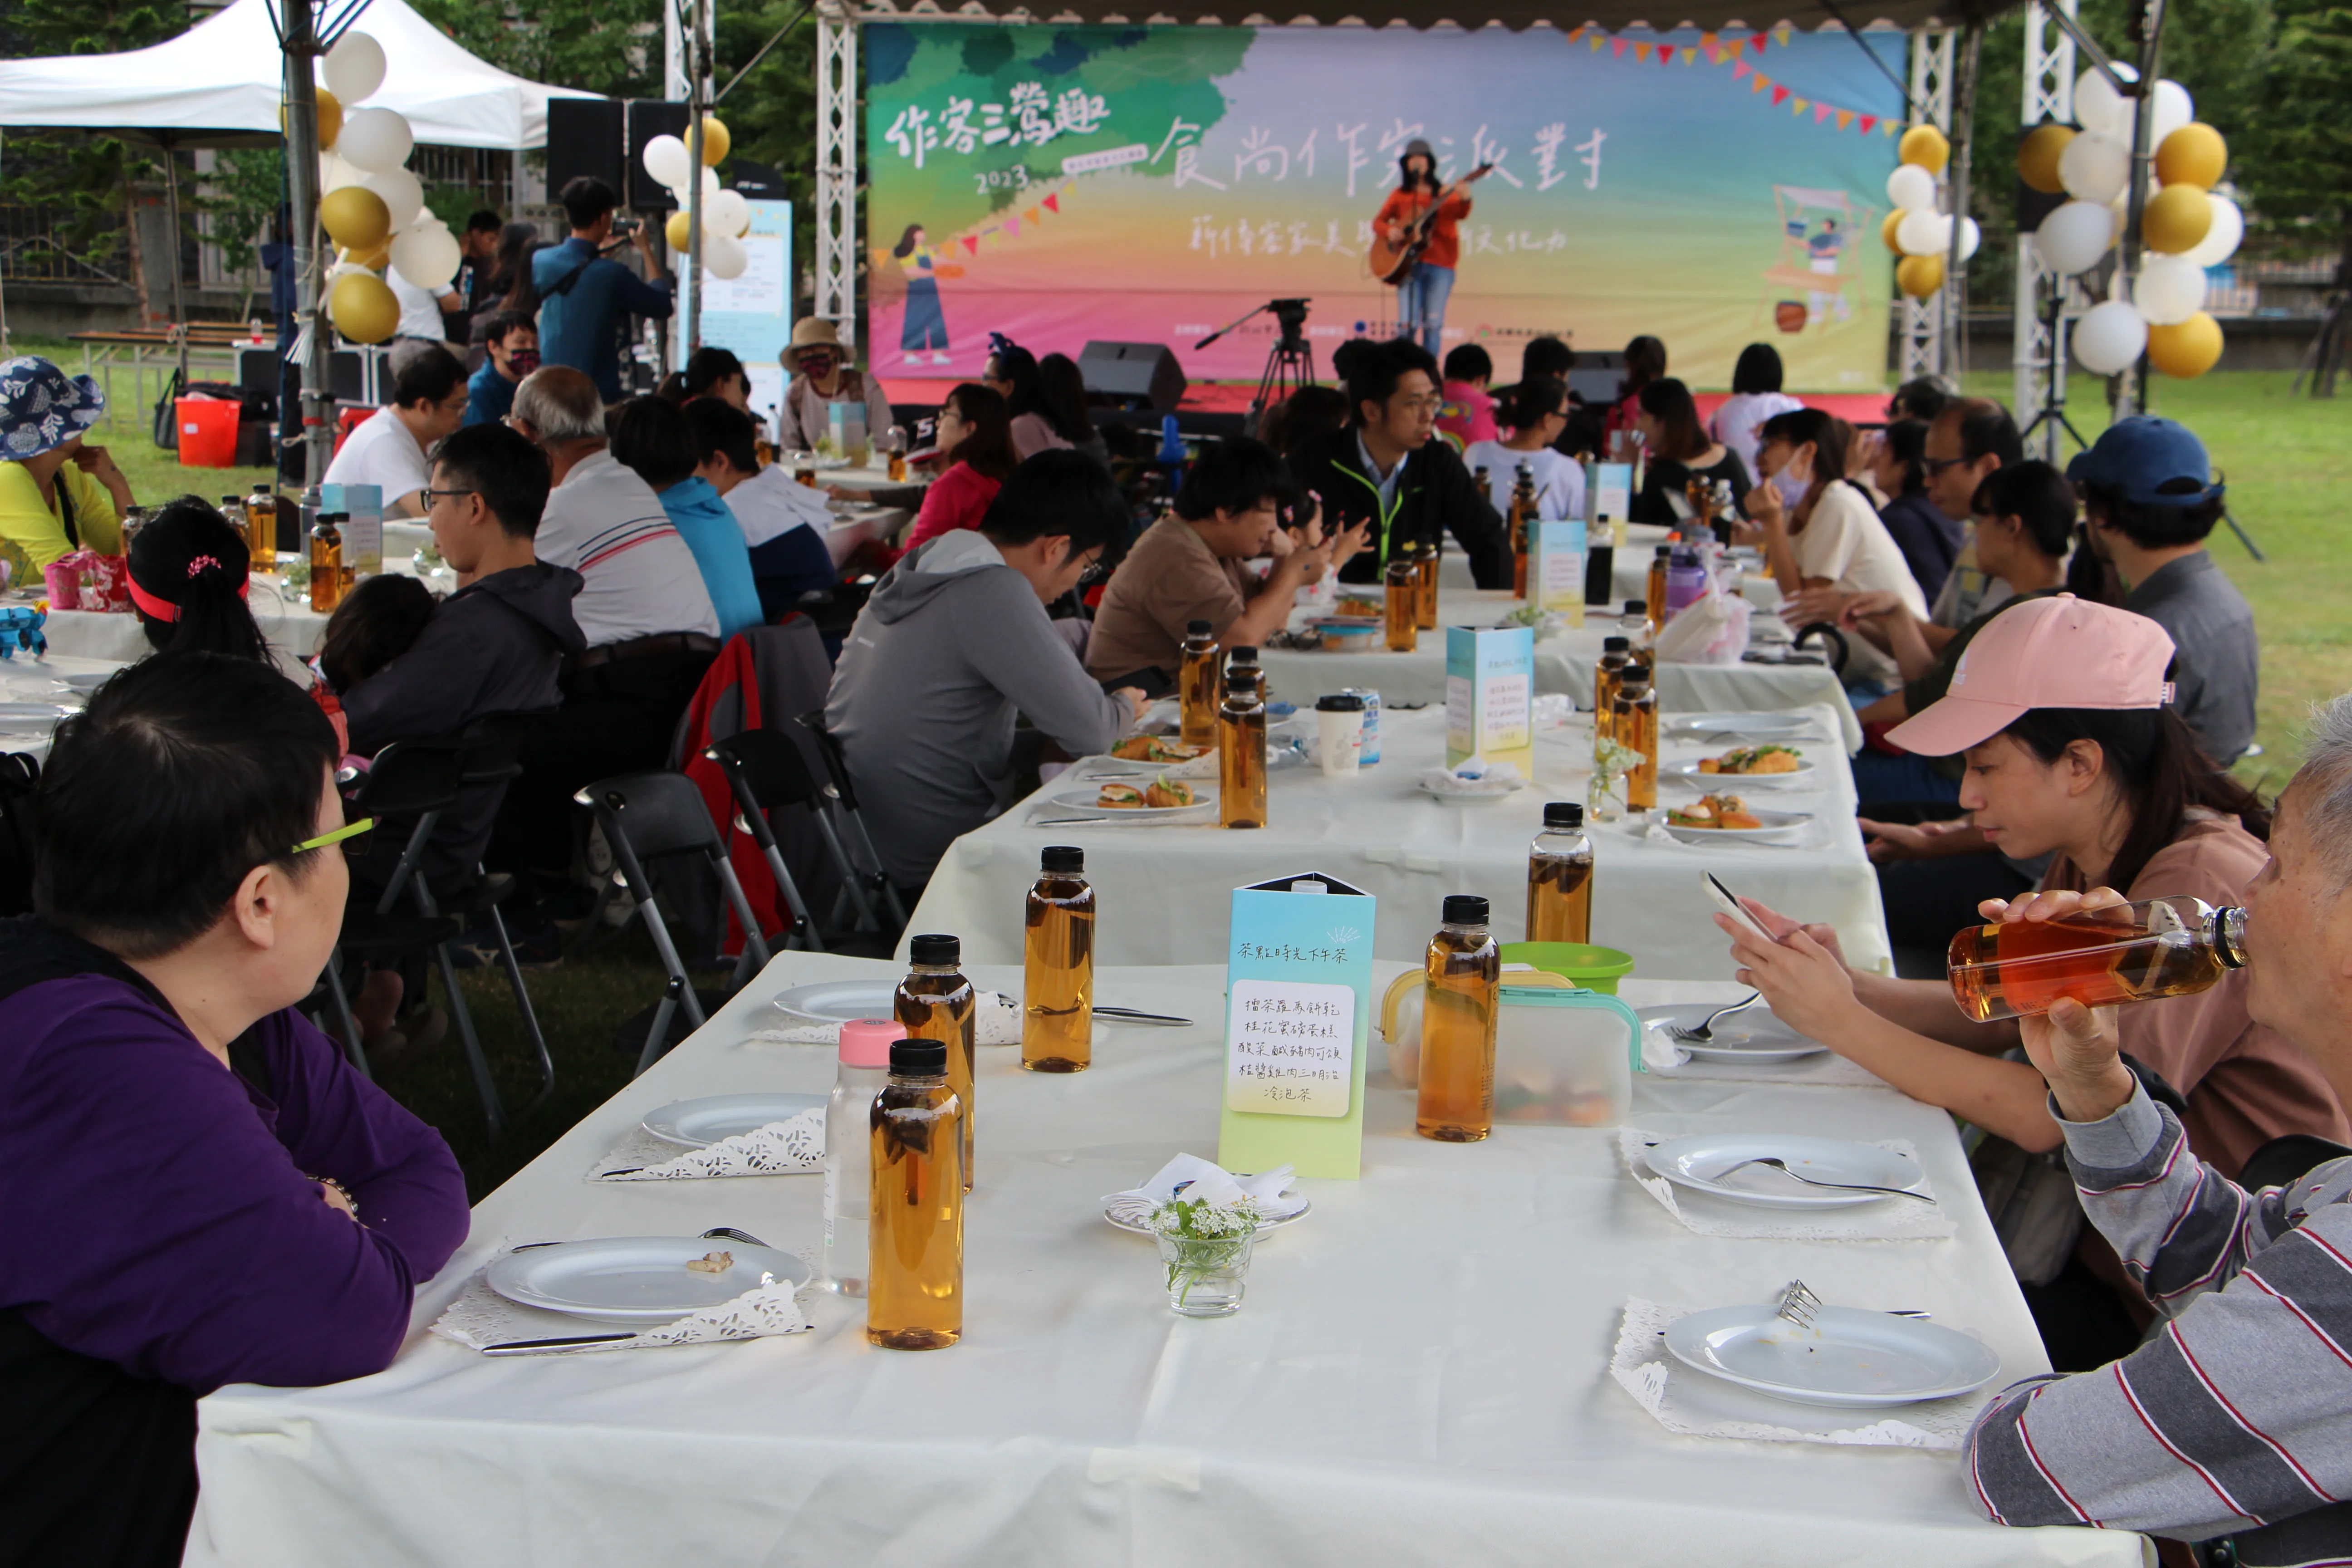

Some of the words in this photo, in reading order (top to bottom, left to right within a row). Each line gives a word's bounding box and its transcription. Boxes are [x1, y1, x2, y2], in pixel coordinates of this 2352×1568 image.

[885, 82, 1111, 169] 作客三鶯趣
[974, 165, 1029, 195] 2023
[1237, 942, 1348, 964] 茶點時光下午茶
[1245, 998, 1340, 1016] 擂茶羅馬餅乾
[1245, 1020, 1338, 1039] 桂花蜜磅蛋糕
[1238, 1042, 1343, 1061] 酸菜鹹豬肉可頌
[1239, 1062, 1339, 1081] 桔醬雞肉三明治
[1264, 1086, 1312, 1102] 冷泡茶
